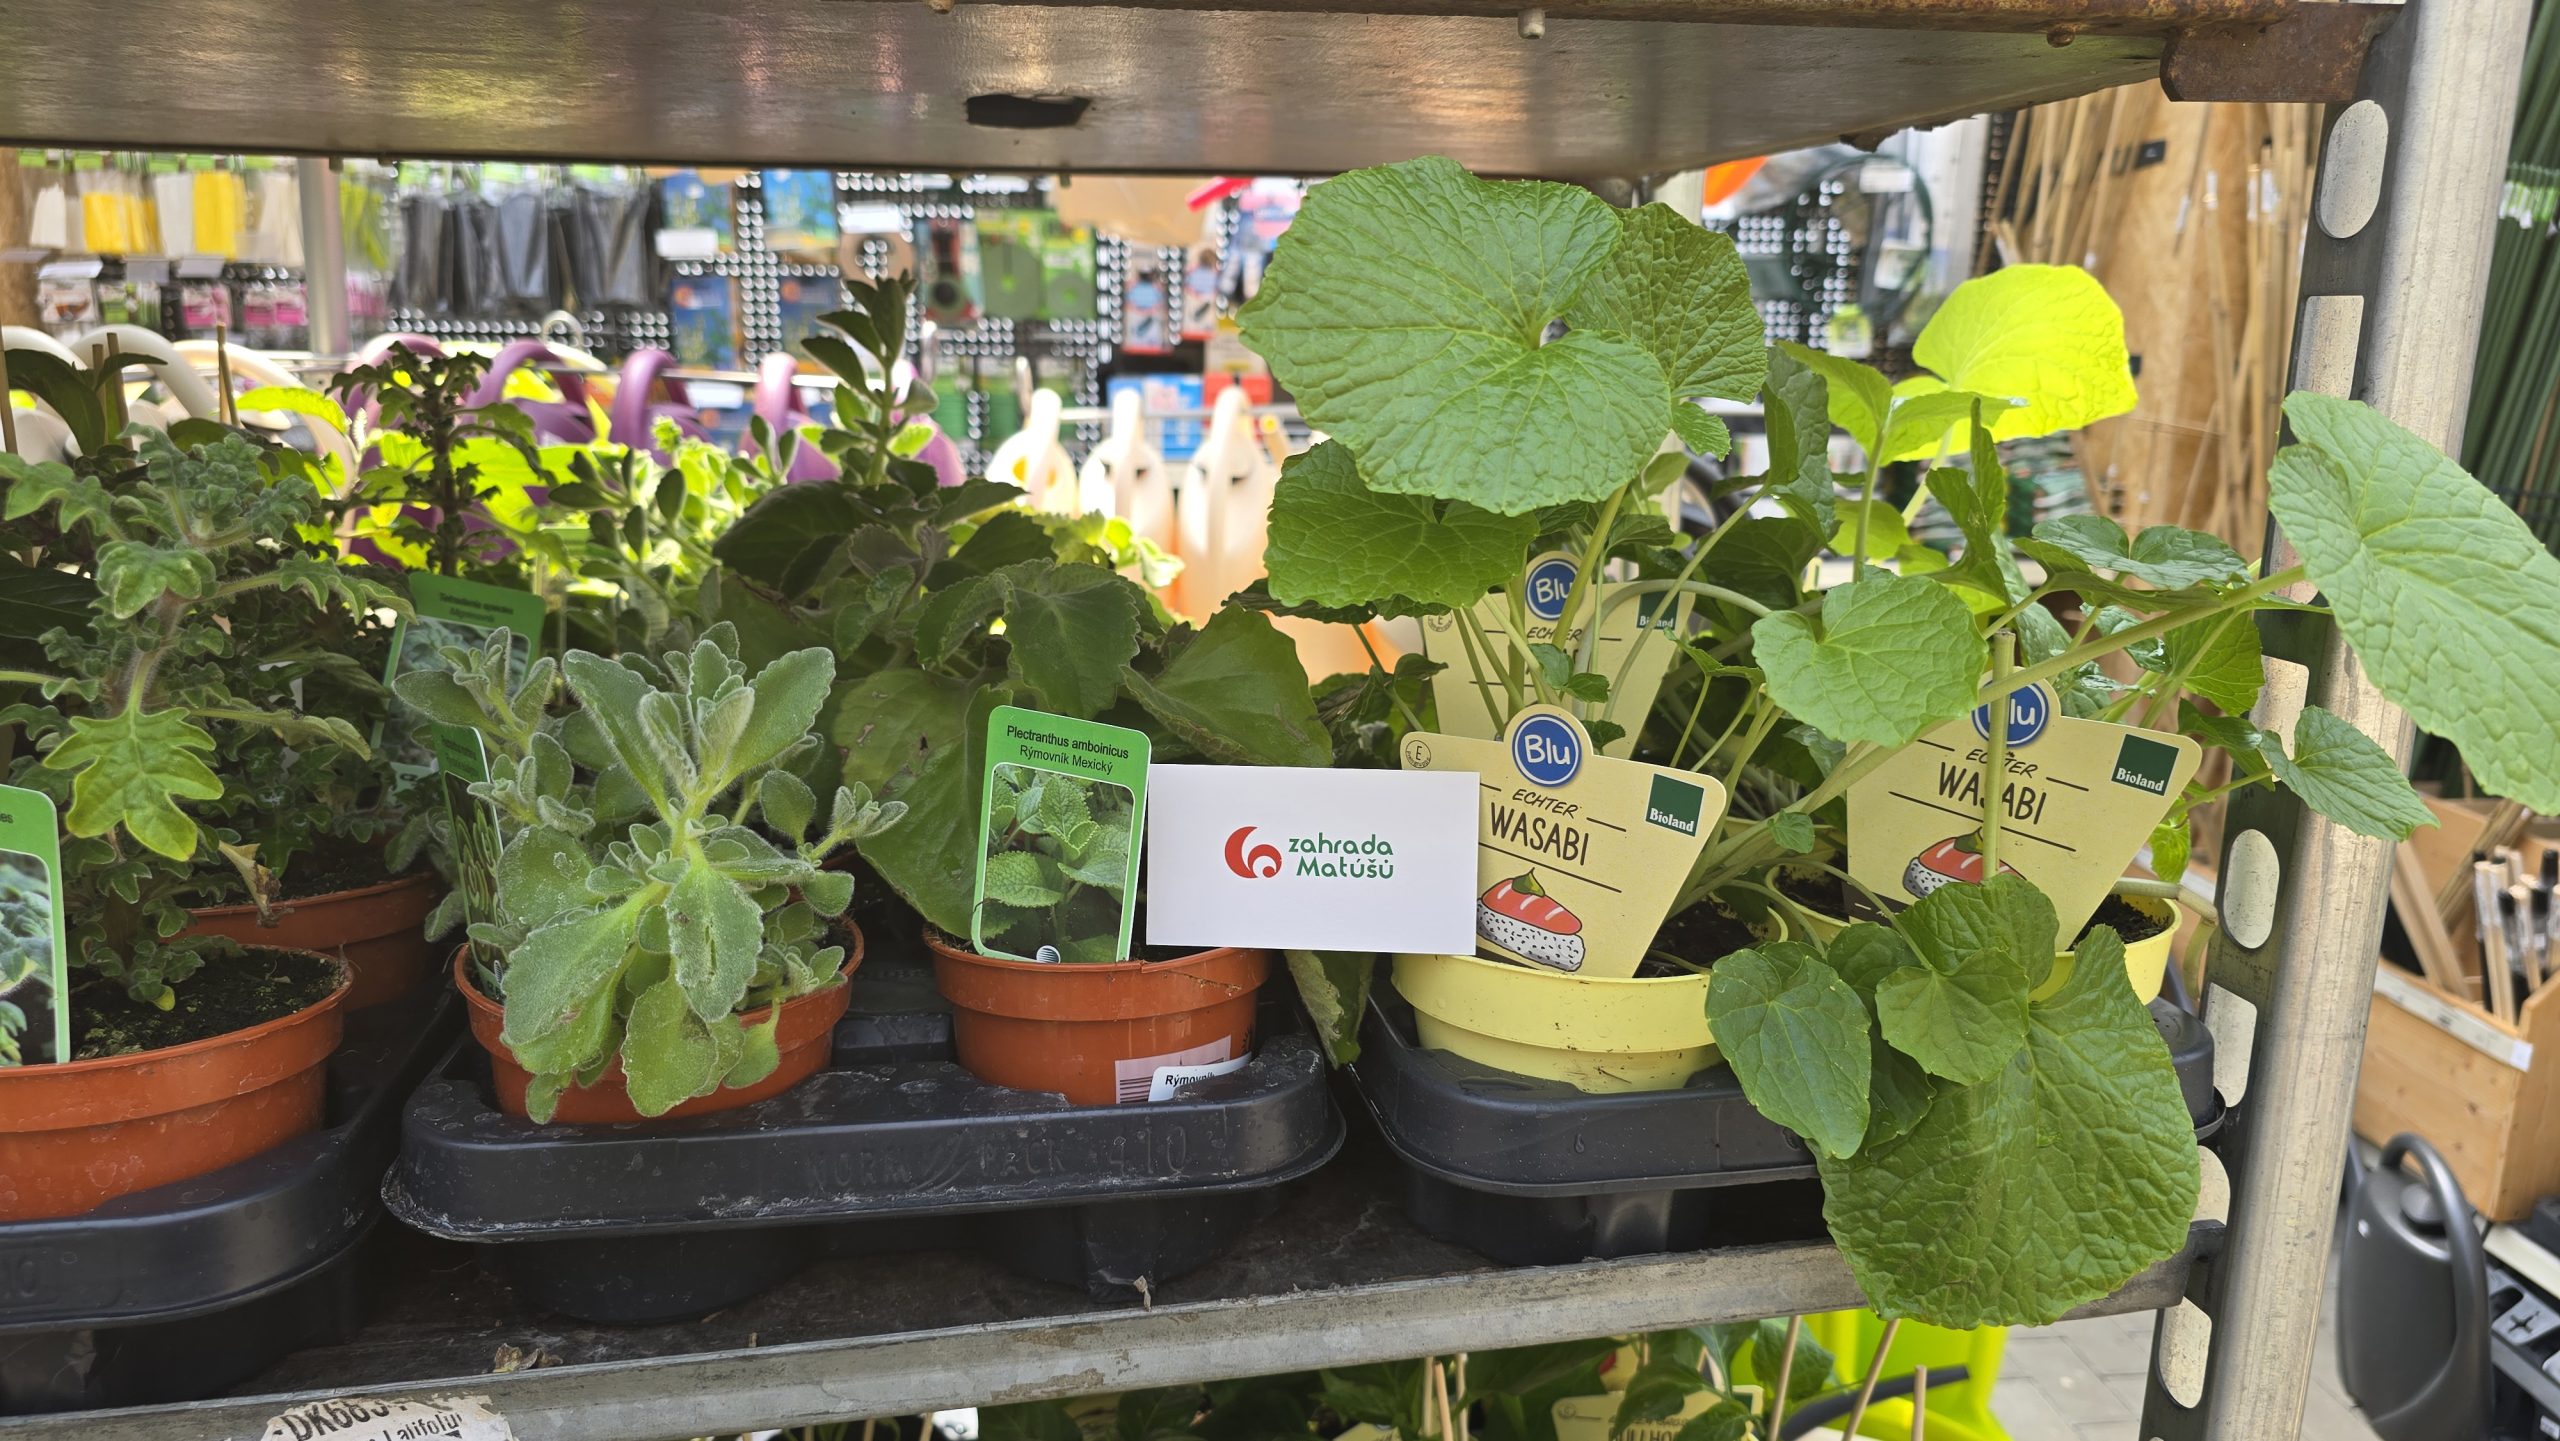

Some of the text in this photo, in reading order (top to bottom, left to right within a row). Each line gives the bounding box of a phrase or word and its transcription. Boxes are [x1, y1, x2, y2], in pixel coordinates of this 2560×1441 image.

[1007, 725, 1129, 759] Plectranthus amboinicus
[1524, 734, 1571, 765] Blu
[1020, 745, 1114, 775] Rýmovník Mexický
[2116, 767, 2164, 792] Bioland
[1512, 789, 1578, 819] ECHTER
[1490, 802, 1589, 866] WASABI
[1649, 808, 1694, 833] Bioland
[1288, 832, 1394, 855] zahrada
